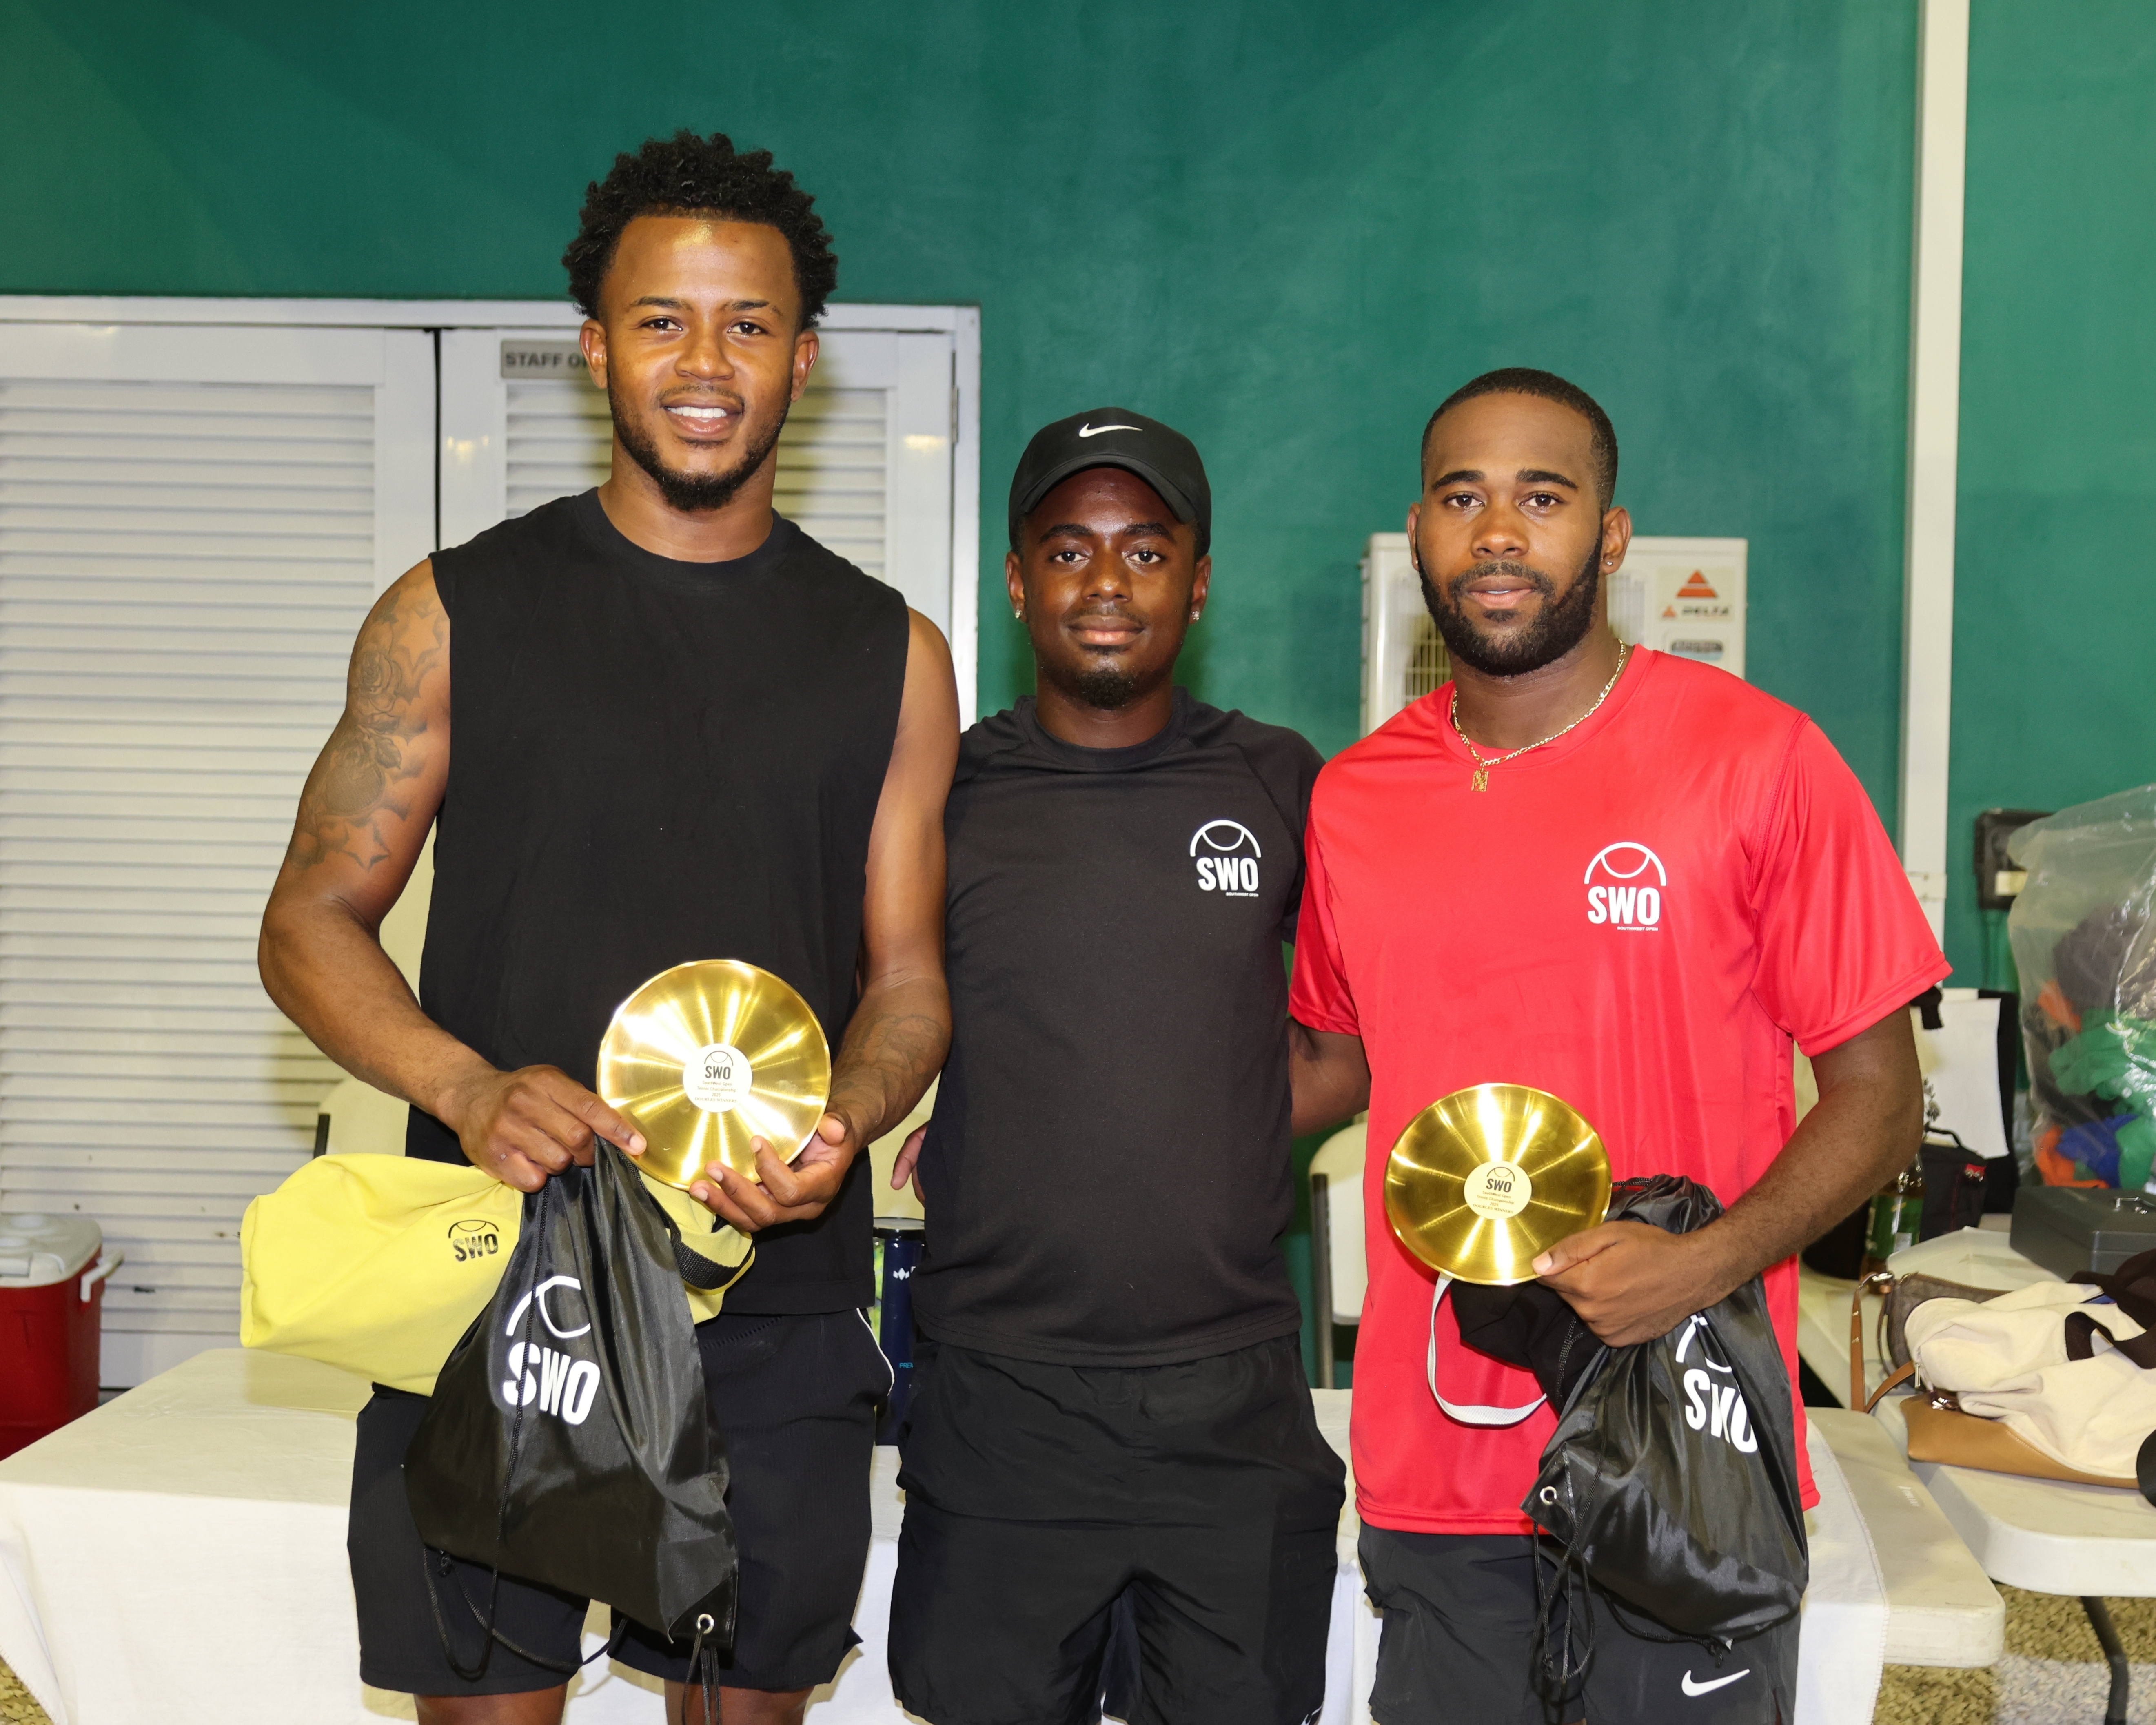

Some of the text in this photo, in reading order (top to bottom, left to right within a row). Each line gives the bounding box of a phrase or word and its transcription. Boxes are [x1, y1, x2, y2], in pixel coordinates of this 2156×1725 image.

[506, 352, 562, 366] STAFF
[1196, 857, 1259, 892] SWO
[1587, 886, 1660, 925] SWO
[705, 1065, 731, 1080] SWO
[1486, 1178, 1512, 1193] SWO
[1489, 1197, 1515, 1205] Championship
[453, 1233, 499, 1262] SWO
[503, 1341, 600, 1425] SWO
